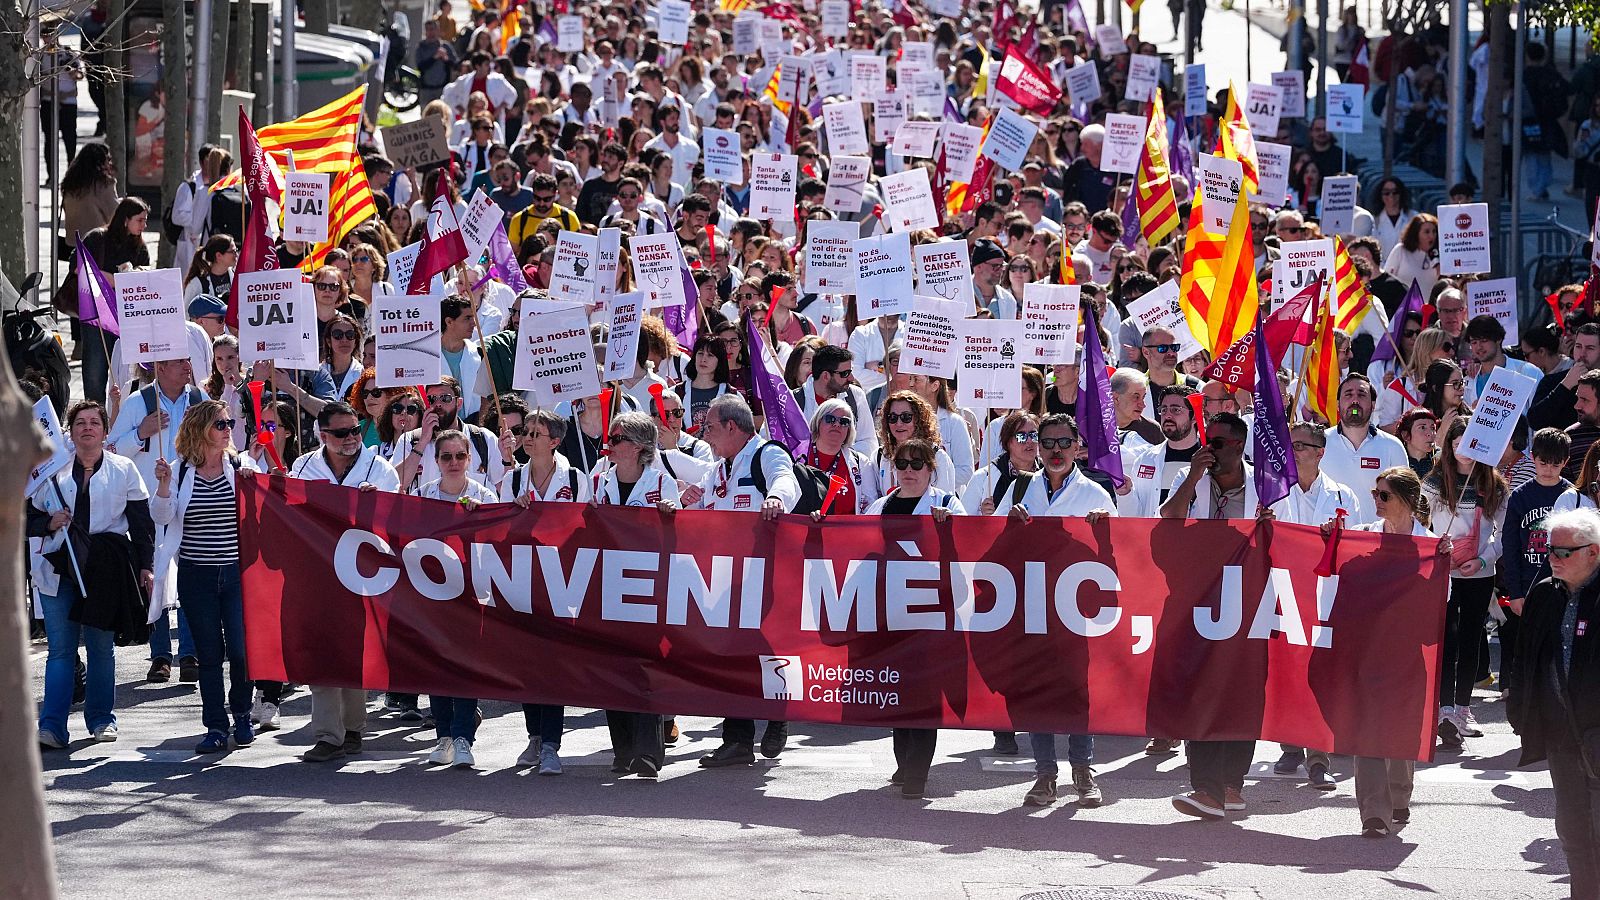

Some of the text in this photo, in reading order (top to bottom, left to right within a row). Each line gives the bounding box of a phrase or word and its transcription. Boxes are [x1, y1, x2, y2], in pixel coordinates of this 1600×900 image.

[1250, 102, 1275, 116] JA!
[397, 149, 440, 166] VAGA
[1204, 170, 1222, 179] Tanta
[291, 182, 322, 190] CONVENI
[1205, 179, 1228, 188] espera
[291, 199, 323, 215] JA!
[560, 240, 582, 249] Pitjor
[636, 244, 666, 254] METGE
[559, 248, 588, 257] atenció
[610, 251, 614, 259] té
[638, 252, 673, 262] CANSAT,
[923, 252, 957, 263] METGE
[1288, 250, 1325, 259] CONVENI
[404, 260, 413, 268] tu!
[811, 260, 847, 268] treballar!
[859, 254, 891, 264] VOCACIÓ,
[924, 260, 964, 271] CANSAT,
[860, 267, 906, 279] EXPLOTACIÓ!
[1290, 268, 1328, 288] JA!
[926, 275, 964, 284] MALTRACTAT
[247, 282, 293, 292] CONVENI
[122, 292, 162, 302] VOCACIÓ,
[247, 292, 281, 302] MÈDIC
[1474, 290, 1506, 300] SANITAT,
[1027, 301, 1040, 309] La
[1474, 297, 1507, 307] PÚBLICA
[125, 307, 178, 317] EXPLOTACIÓ!
[248, 302, 294, 326] JA!
[380, 308, 420, 320] Tot té
[614, 304, 635, 314] METGE
[1138, 306, 1160, 321] Tanta
[613, 313, 637, 325] CANSAT,
[911, 311, 950, 324] Psicòlegs,
[1143, 309, 1169, 327] espera
[380, 321, 434, 334] un límit
[910, 319, 954, 331] odontòlegs,
[529, 327, 586, 344] La nostra
[907, 334, 931, 343] també
[908, 327, 958, 340] farmacòlegs,
[1025, 333, 1065, 341] conveni
[531, 346, 557, 356] veu,
[906, 342, 946, 354] facultatius
[965, 345, 998, 353] espera
[534, 351, 586, 367] el nostre
[536, 363, 582, 378] conveni
[964, 361, 1015, 370] desespera
[1228, 367, 1243, 383] de
[1490, 383, 1513, 397] Menys
[1485, 394, 1516, 410] corbates
[1485, 407, 1499, 416] més
[1476, 415, 1496, 429] bates!
[1277, 446, 1287, 464] de
[334, 528, 1338, 655] CONVENI MÈDIC, JA!
[808, 663, 900, 686] Metges de
[807, 684, 900, 709] Catalunya
